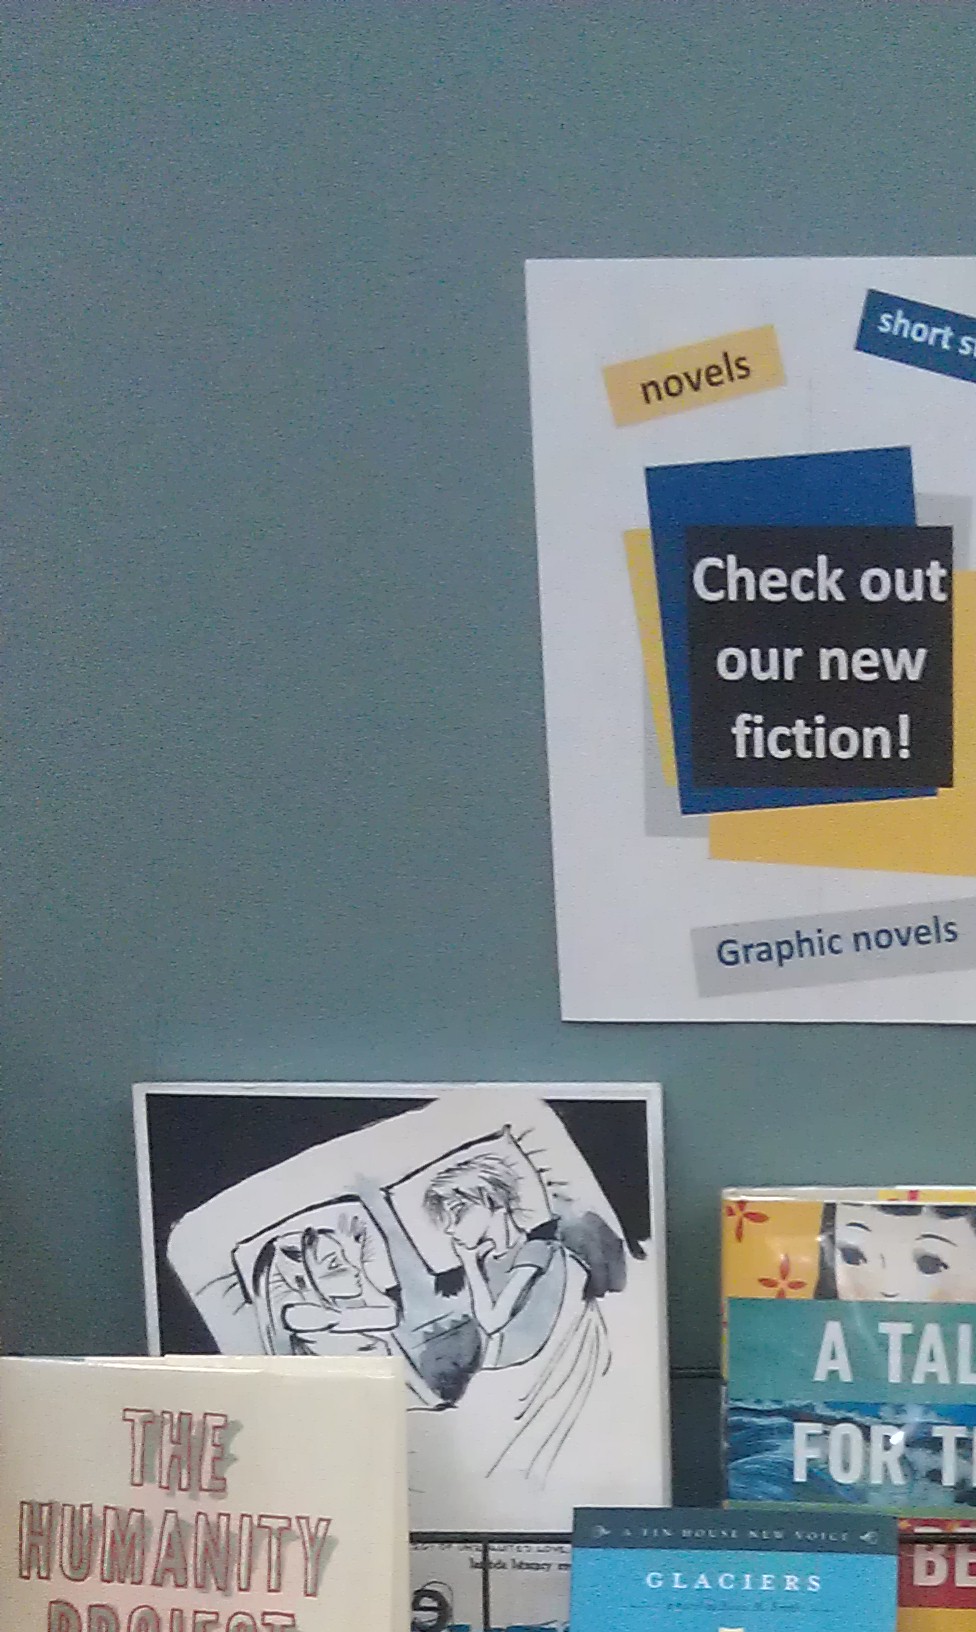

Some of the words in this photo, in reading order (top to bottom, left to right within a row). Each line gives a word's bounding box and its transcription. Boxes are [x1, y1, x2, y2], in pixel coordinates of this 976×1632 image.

[877, 309, 953, 351] short
[641, 351, 751, 404] novels
[692, 556, 846, 602] Check
[860, 567, 948, 602] out
[716, 647, 803, 682] our
[818, 647, 927, 682] new
[731, 714, 911, 759] fiction!
[716, 929, 844, 969] Graphic
[853, 916, 959, 953] novels
[813, 1321, 853, 1383] A
[123, 1408, 232, 1492] THE
[793, 1423, 904, 1484] FOR
[18, 1500, 333, 1598] HUMANITY
[646, 1572, 822, 1592] GLACIERS
